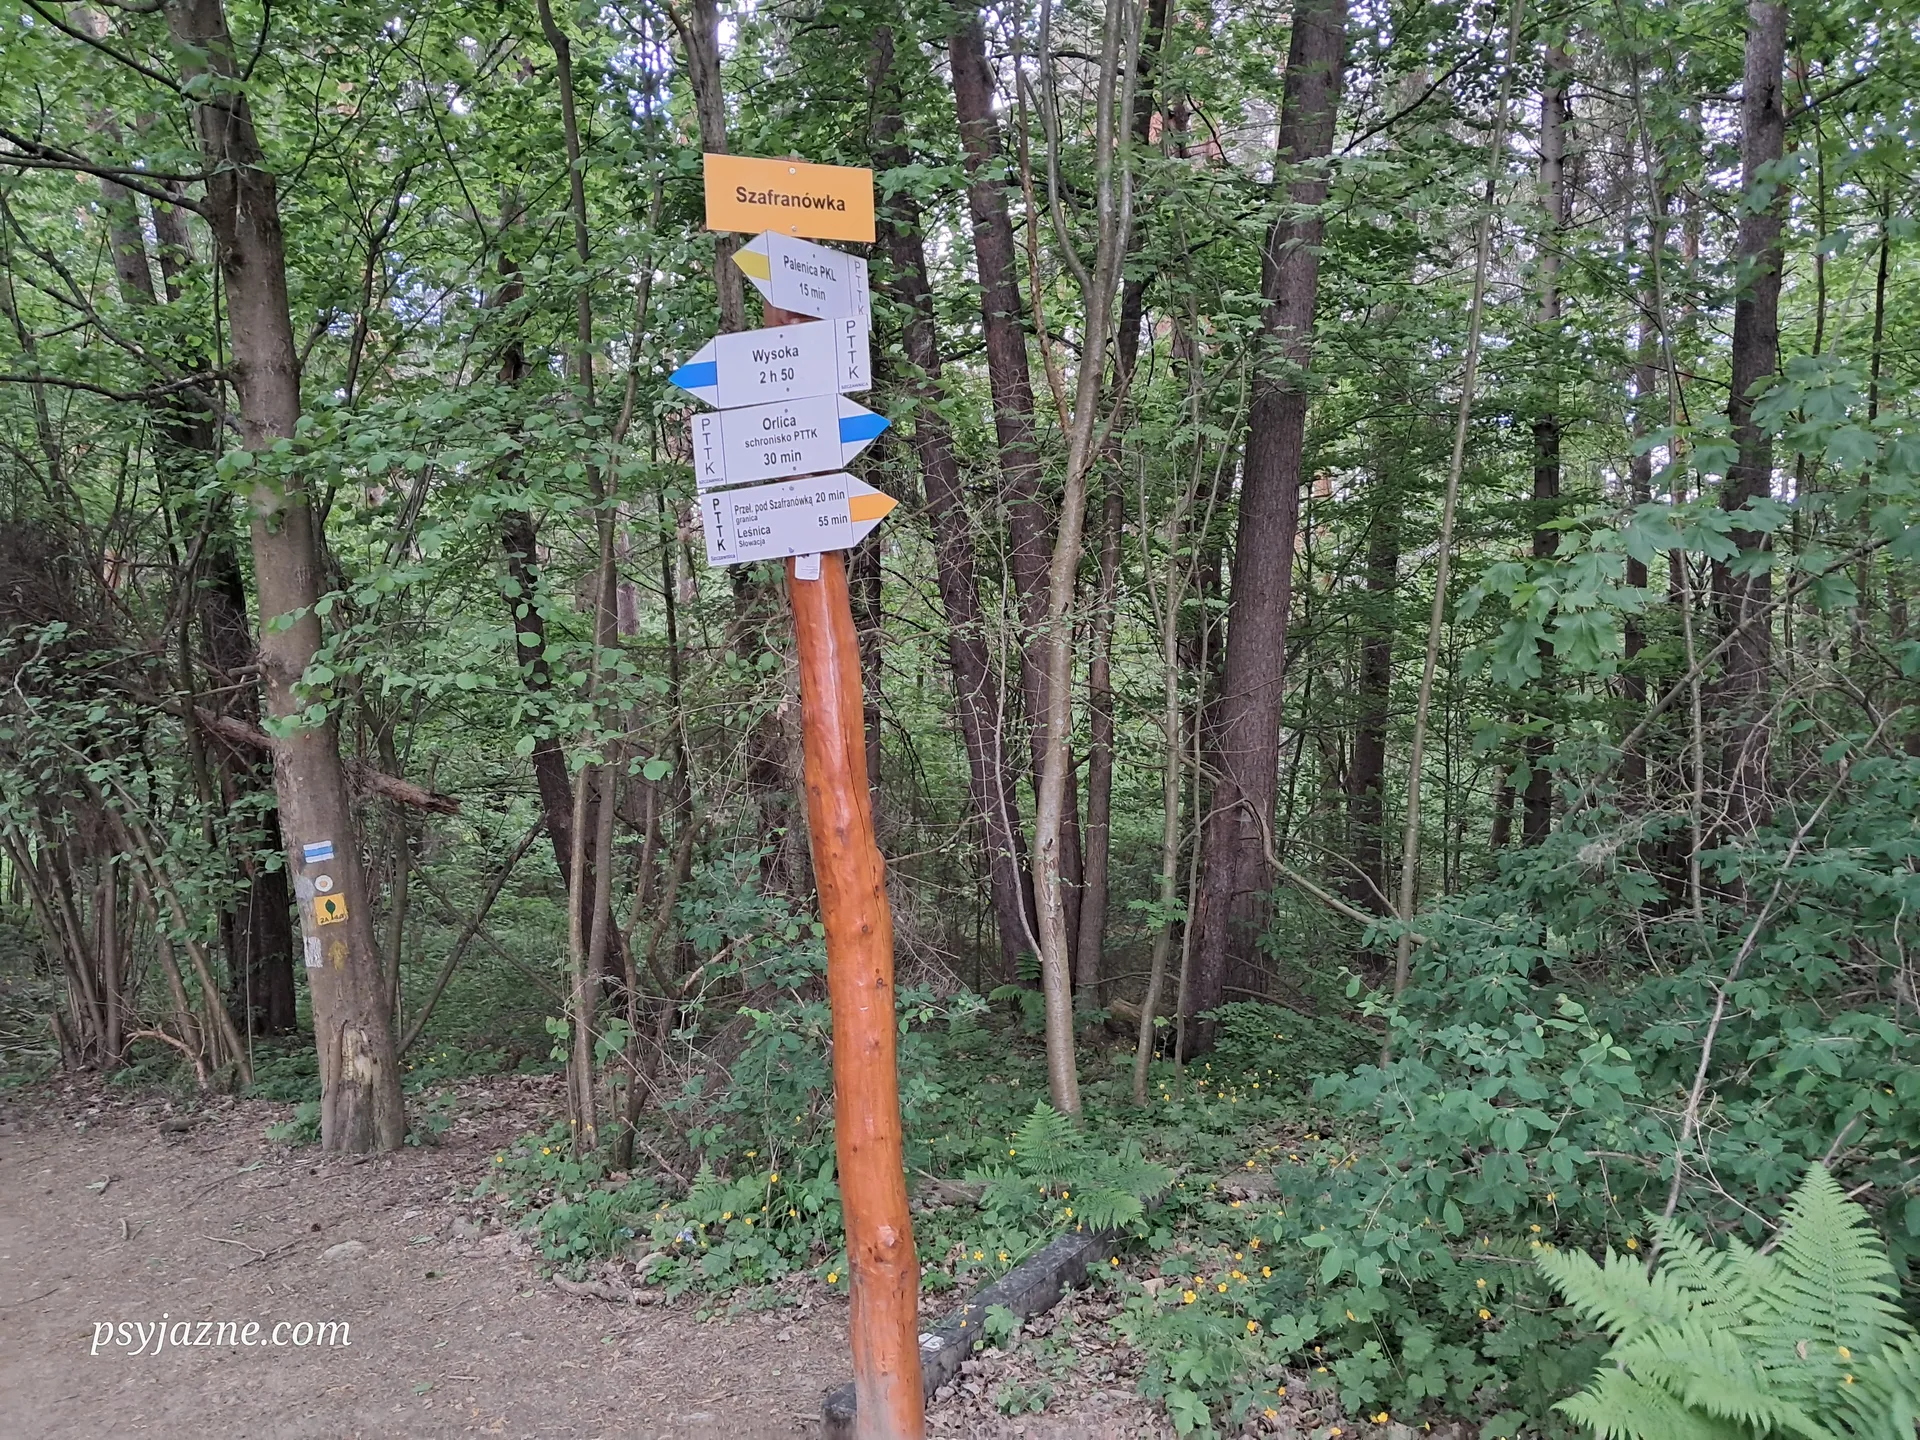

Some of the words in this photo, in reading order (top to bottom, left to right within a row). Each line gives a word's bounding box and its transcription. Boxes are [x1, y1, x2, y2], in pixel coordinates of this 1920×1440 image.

[736, 186, 846, 211] Szafranówka
[783, 255, 818, 276] Palenica
[820, 265, 837, 282] PKL
[799, 282, 809, 297] 15
[811, 287, 826, 301] min
[854, 261, 864, 315] PTTK
[752, 345, 799, 364] Wysoka
[846, 320, 859, 379] PTTK
[759, 371, 767, 384] 2
[769, 370, 778, 383] h
[781, 367, 795, 381] 50
[762, 415, 797, 431] Orlica
[701, 418, 716, 475] PTTK
[745, 433, 792, 448] schronisko
[794, 428, 818, 442] PTTK
[763, 452, 778, 466] 30
[780, 450, 802, 464] min
[755, 501, 768, 514] pod
[769, 495, 813, 510] Szafranówką
[815, 492, 826, 503] 20
[828, 490, 845, 501] min
[712, 498, 726, 551] PTTK
[736, 515, 758, 526] granica
[737, 526, 771, 539] Leśnica
[818, 516, 829, 527] 55
[831, 514, 848, 525] min
